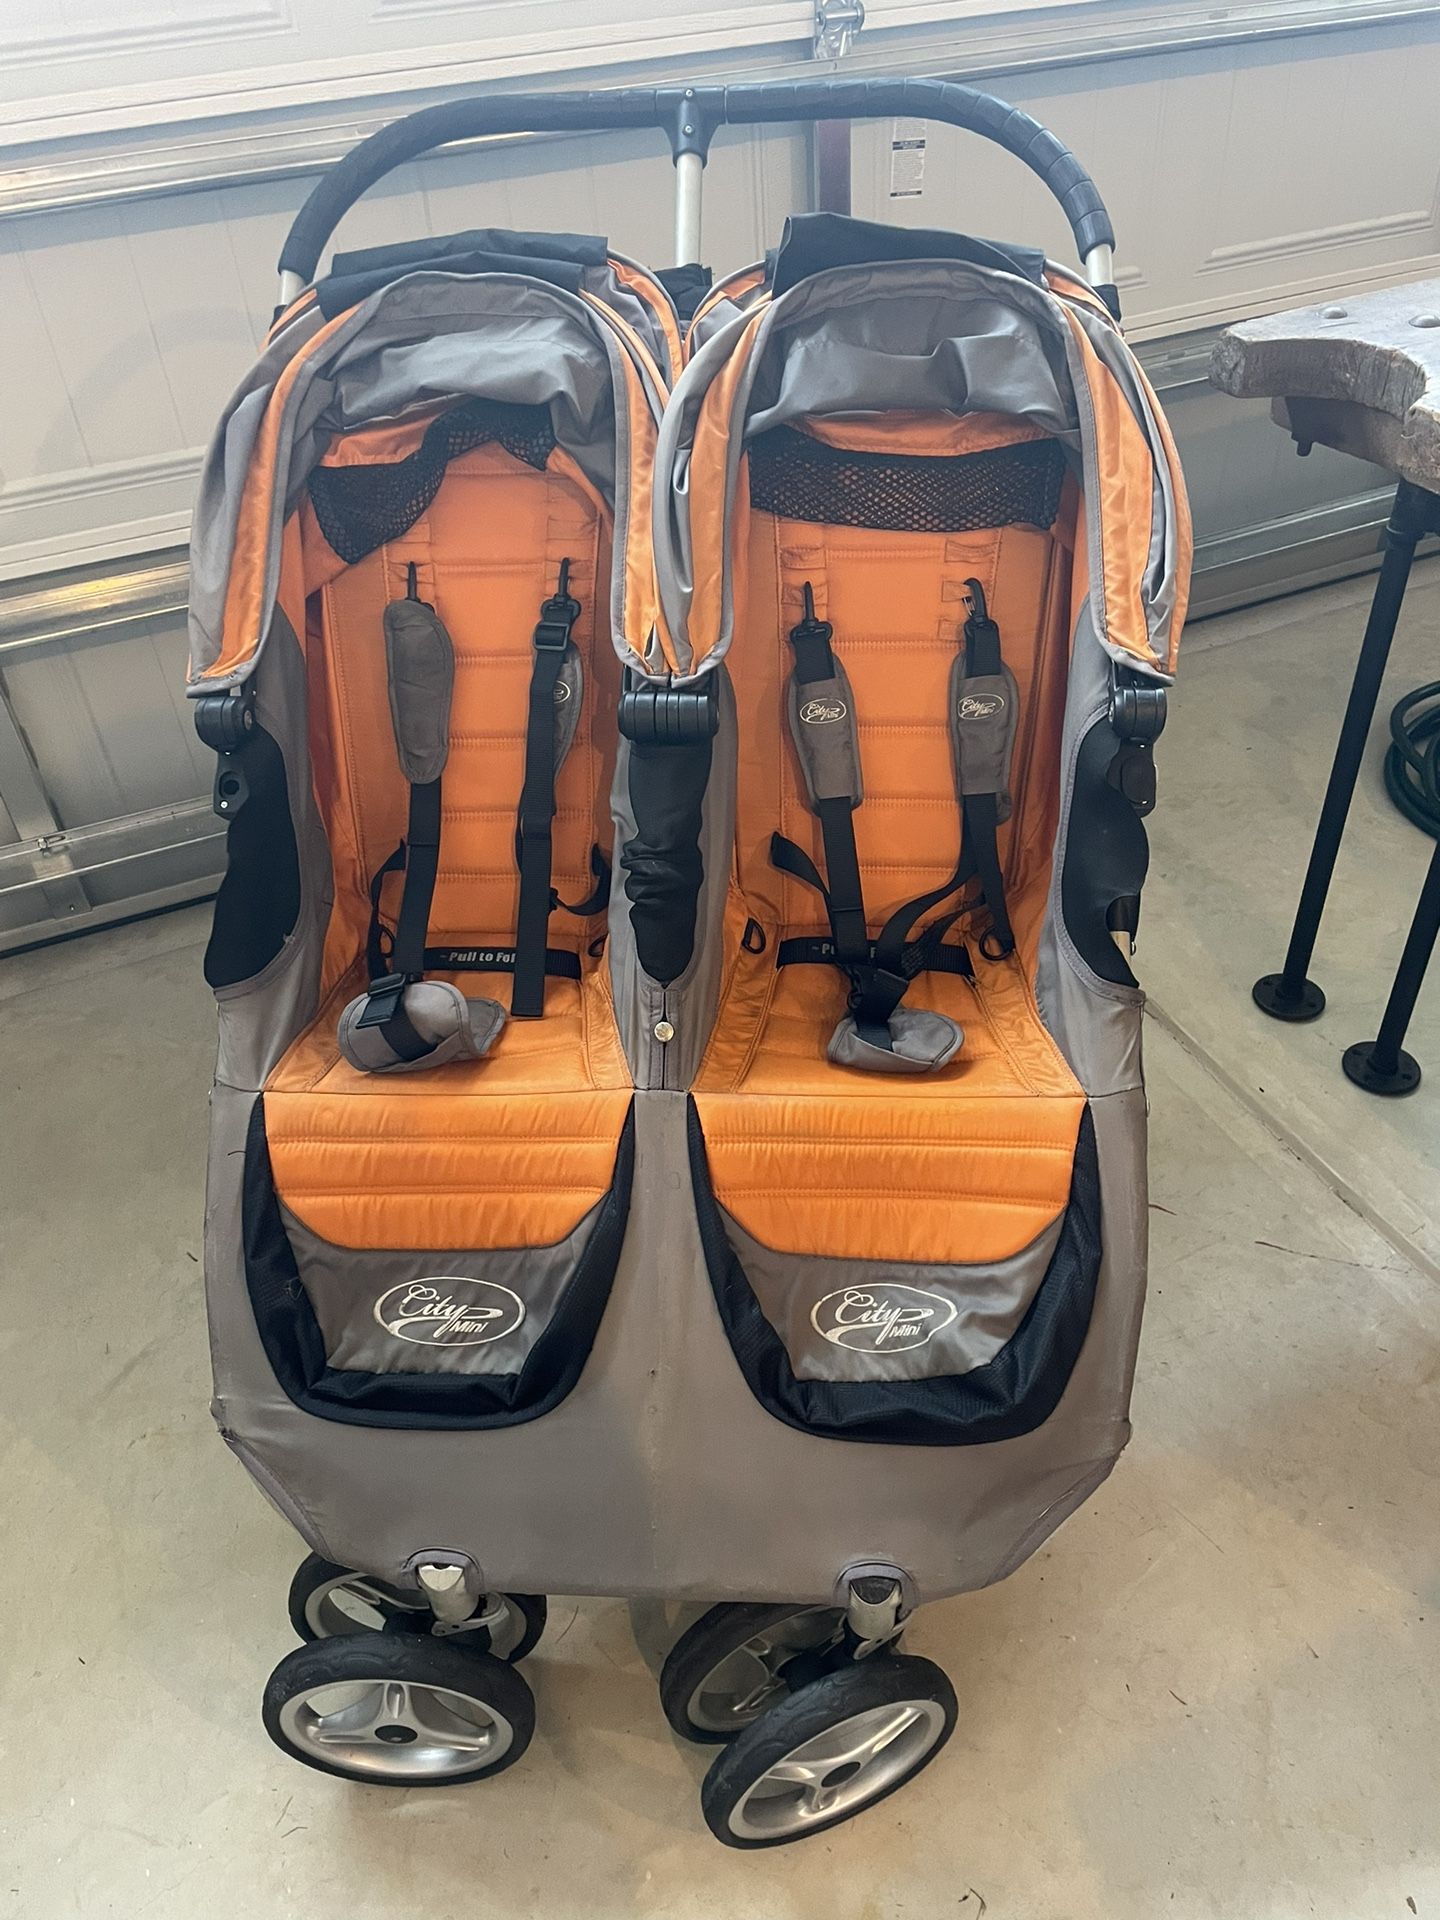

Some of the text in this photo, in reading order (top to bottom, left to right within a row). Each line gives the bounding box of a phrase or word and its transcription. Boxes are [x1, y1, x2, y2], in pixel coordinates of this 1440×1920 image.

[449, 951, 516, 963] Pull to Fol
[399, 1284, 503, 1338] City
[835, 1290, 934, 1345] City
